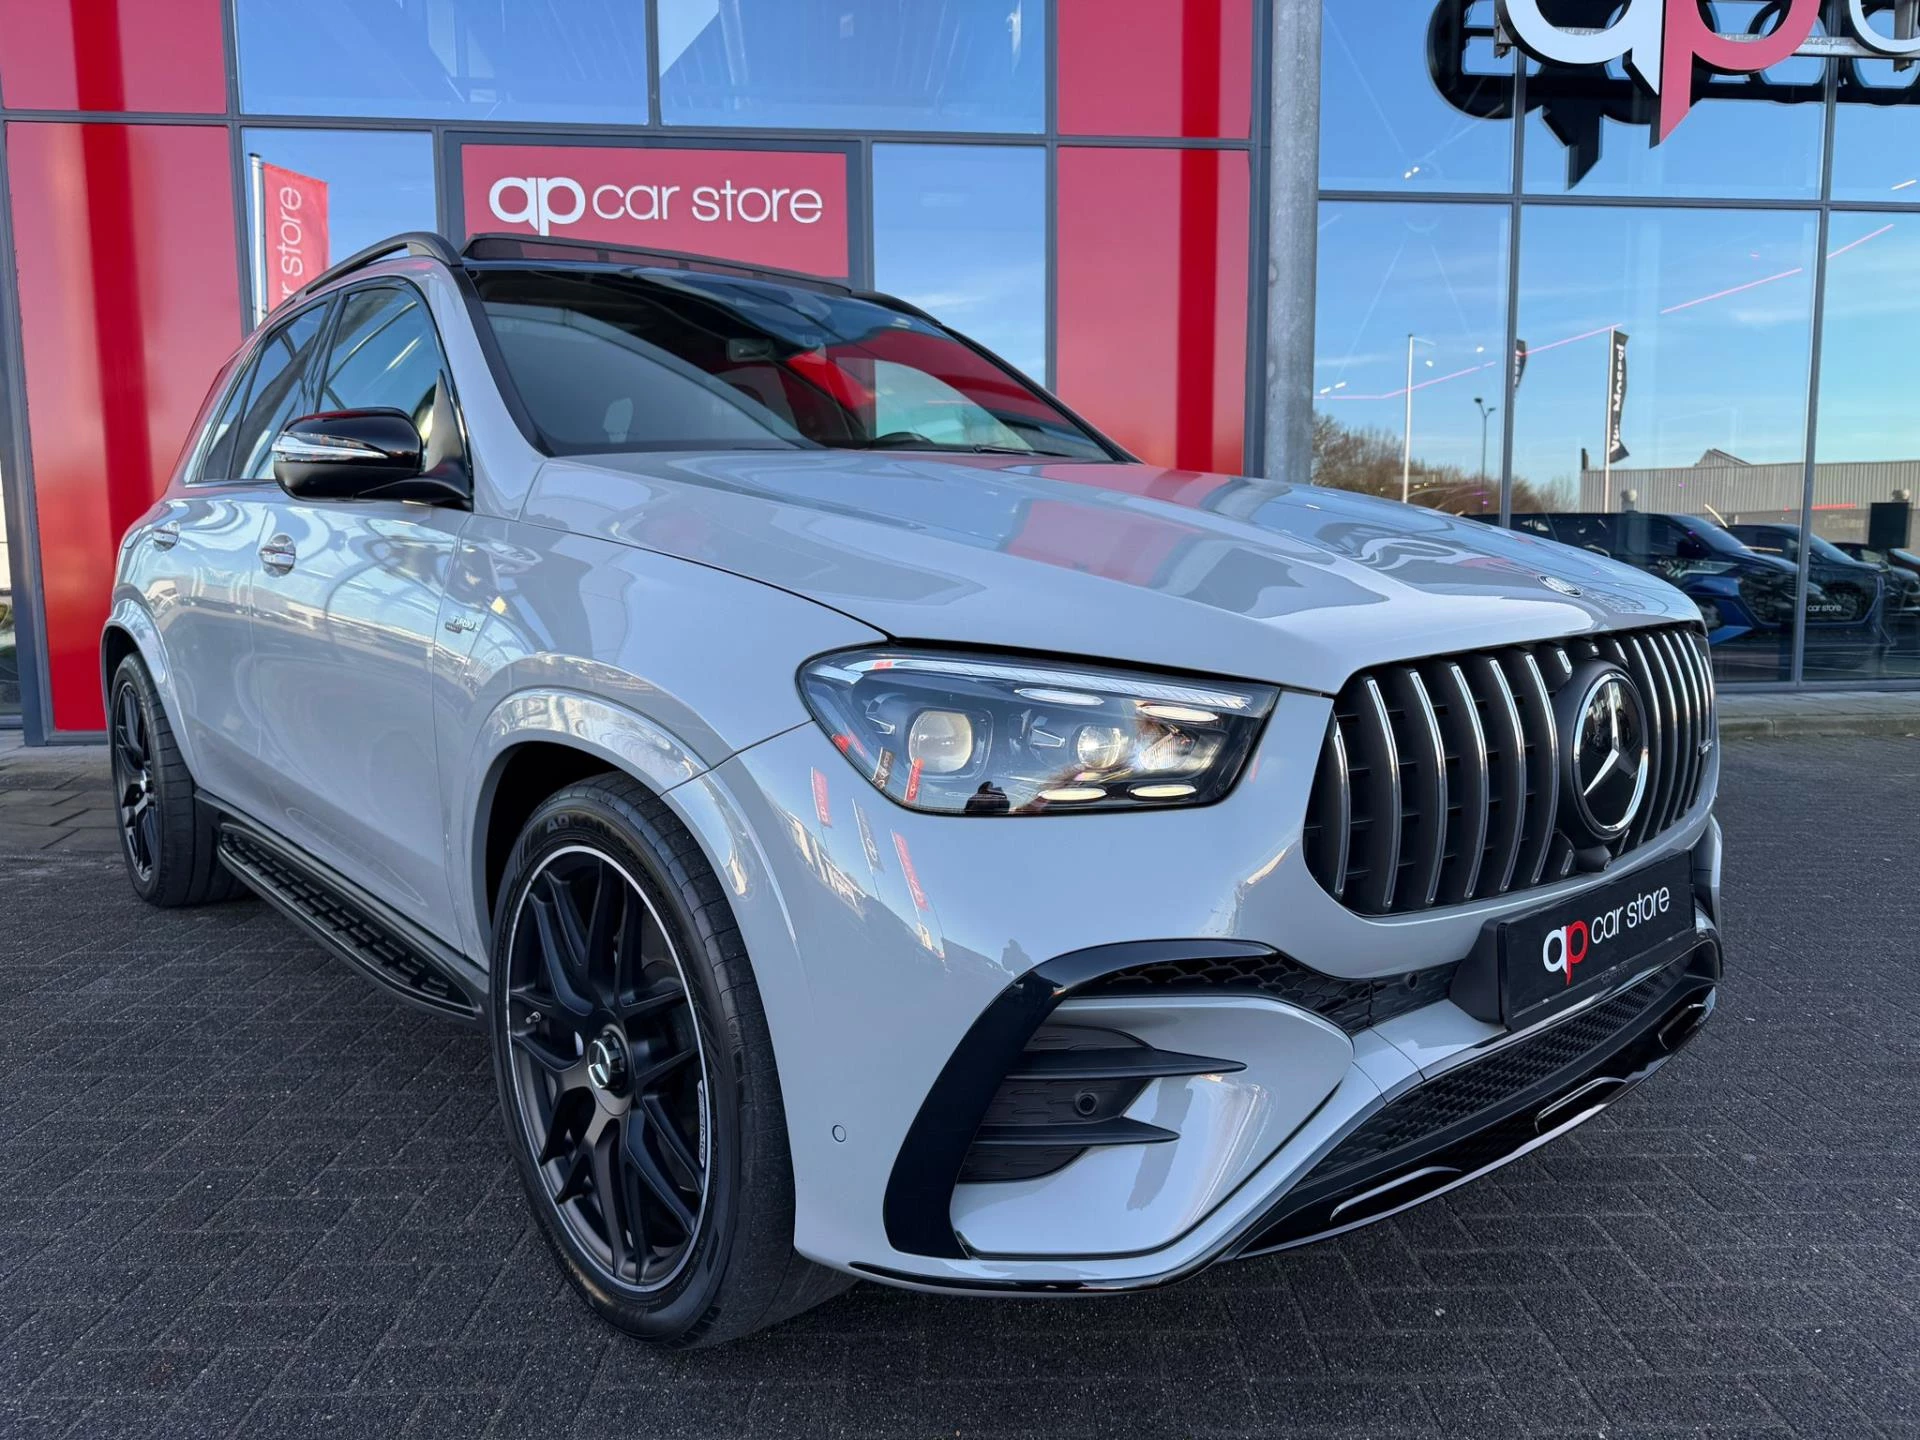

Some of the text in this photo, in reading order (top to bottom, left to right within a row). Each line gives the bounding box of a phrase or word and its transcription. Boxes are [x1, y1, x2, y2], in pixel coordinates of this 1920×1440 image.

[276, 187, 303, 277] store
[592, 184, 681, 221] car
[691, 179, 823, 224] store
[1821, 604, 1843, 612] store
[1542, 920, 1589, 987] ap
[1591, 903, 1624, 944] car
[1626, 886, 1670, 929] store
